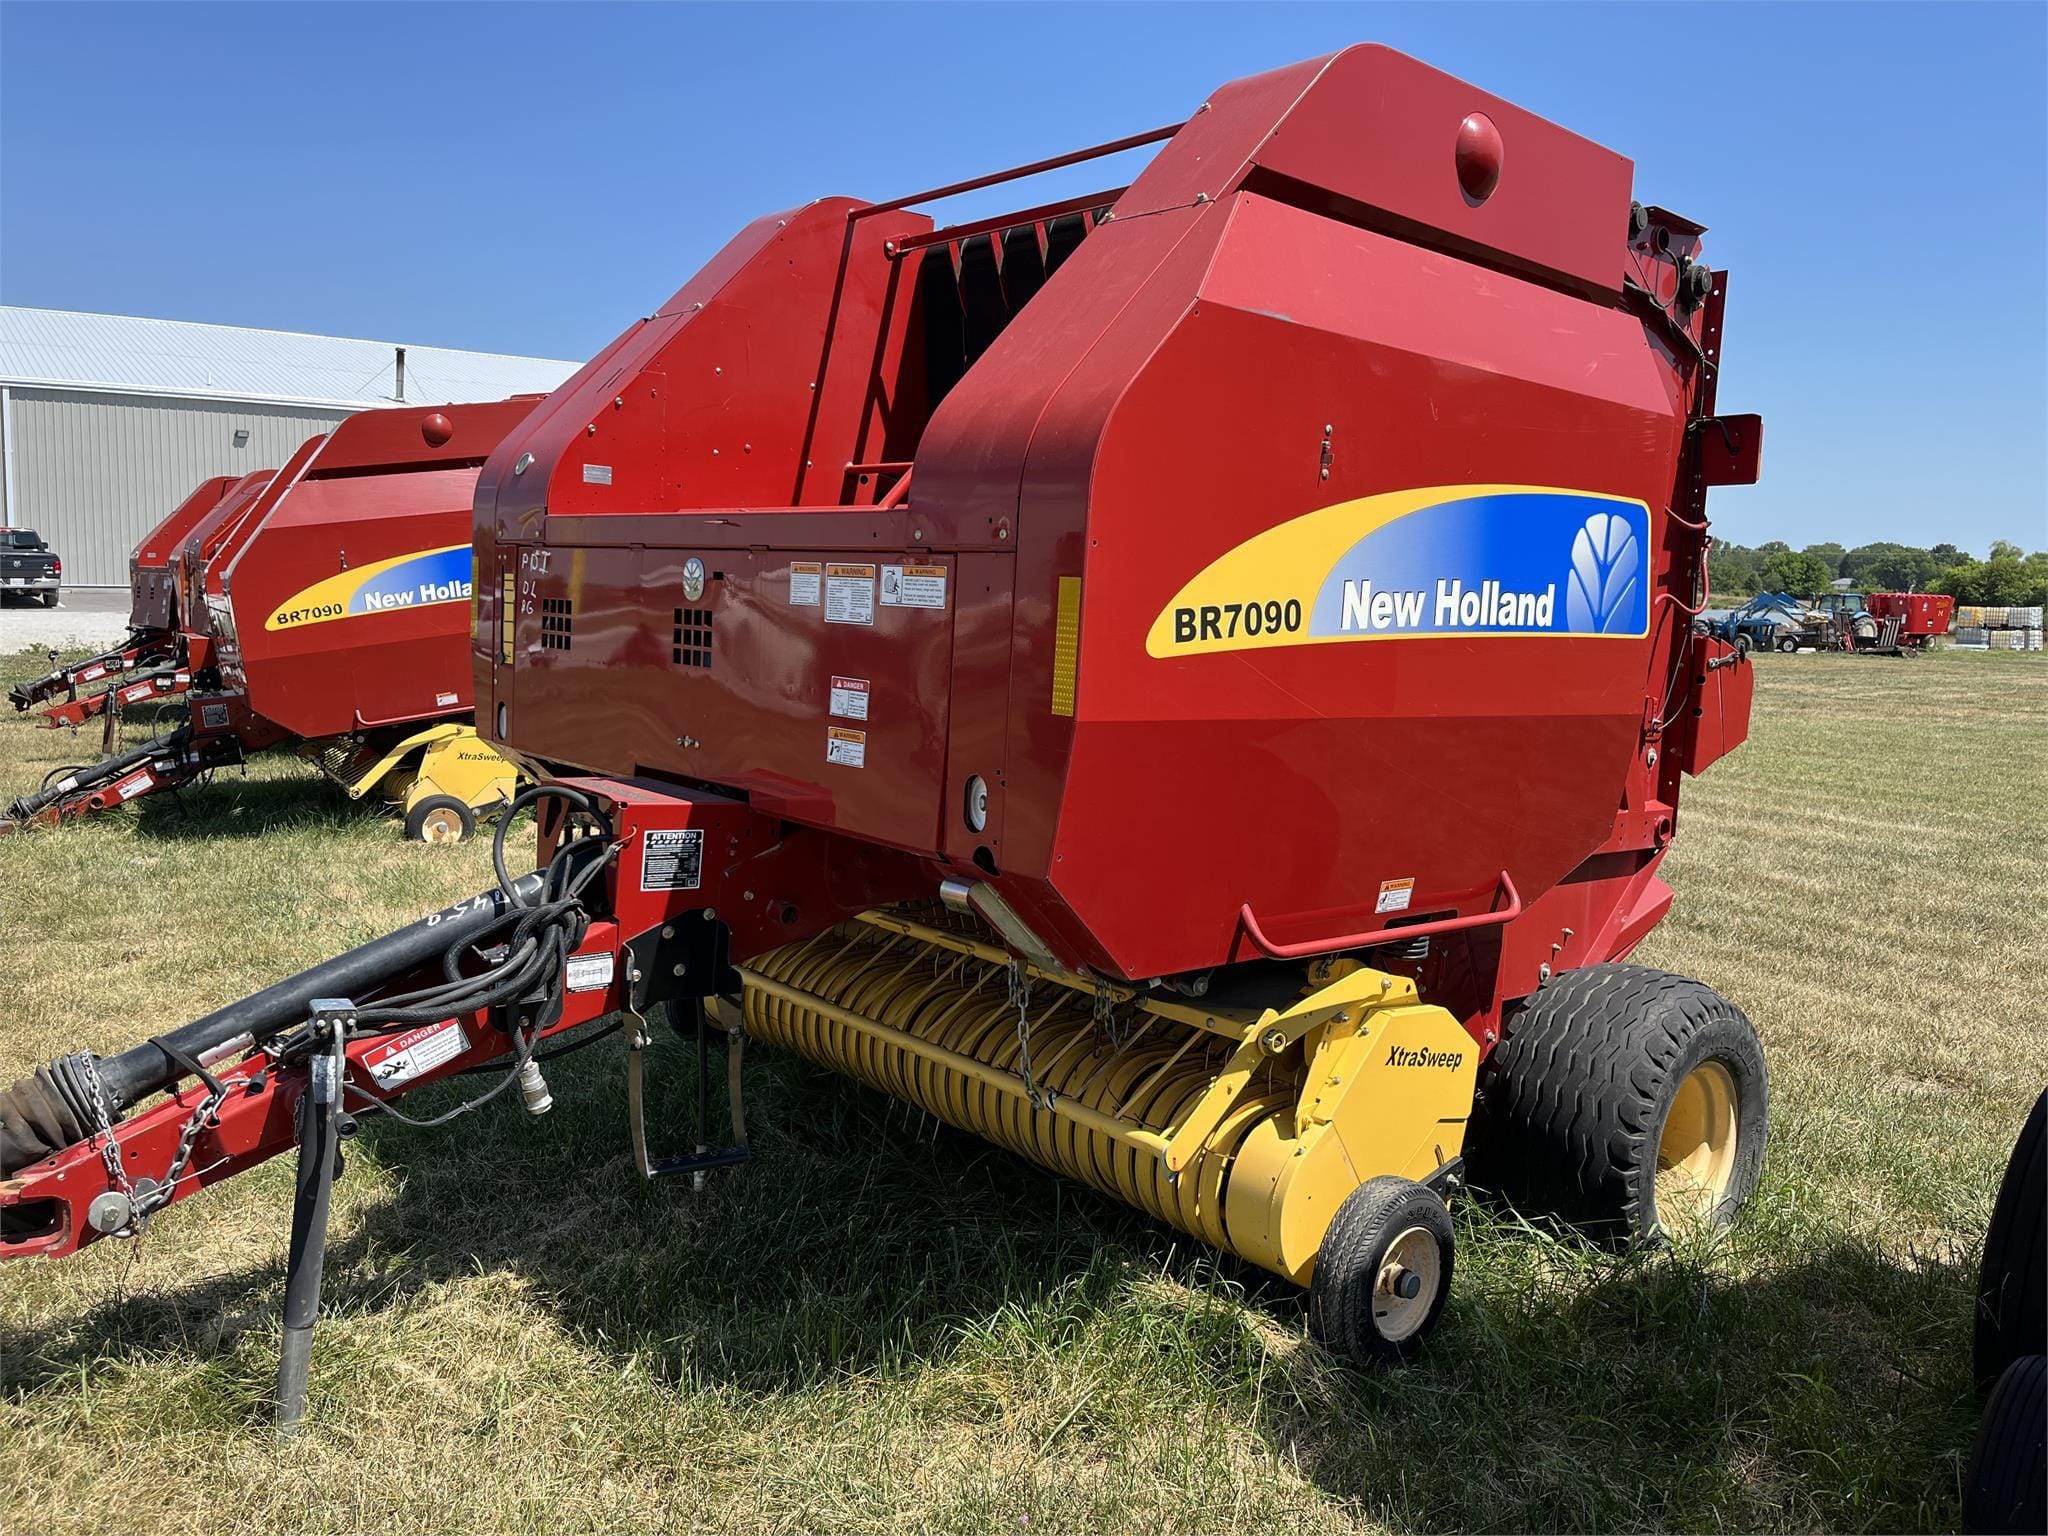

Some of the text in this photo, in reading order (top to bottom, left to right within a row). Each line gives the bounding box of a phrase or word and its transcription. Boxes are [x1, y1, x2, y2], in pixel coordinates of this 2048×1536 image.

[841, 568, 866, 576] WARNING
[364, 591, 413, 610] New
[1341, 579, 1555, 631] New Holland
[277, 603, 343, 625] BR7090
[1174, 599, 1301, 644] BR7090
[843, 681, 864, 690] DANGER
[839, 732, 861, 740] WARNING
[651, 832, 697, 841] ATTENTION
[399, 1023, 441, 1049] DANGER
[1385, 1046, 1463, 1072] XtraSweep
